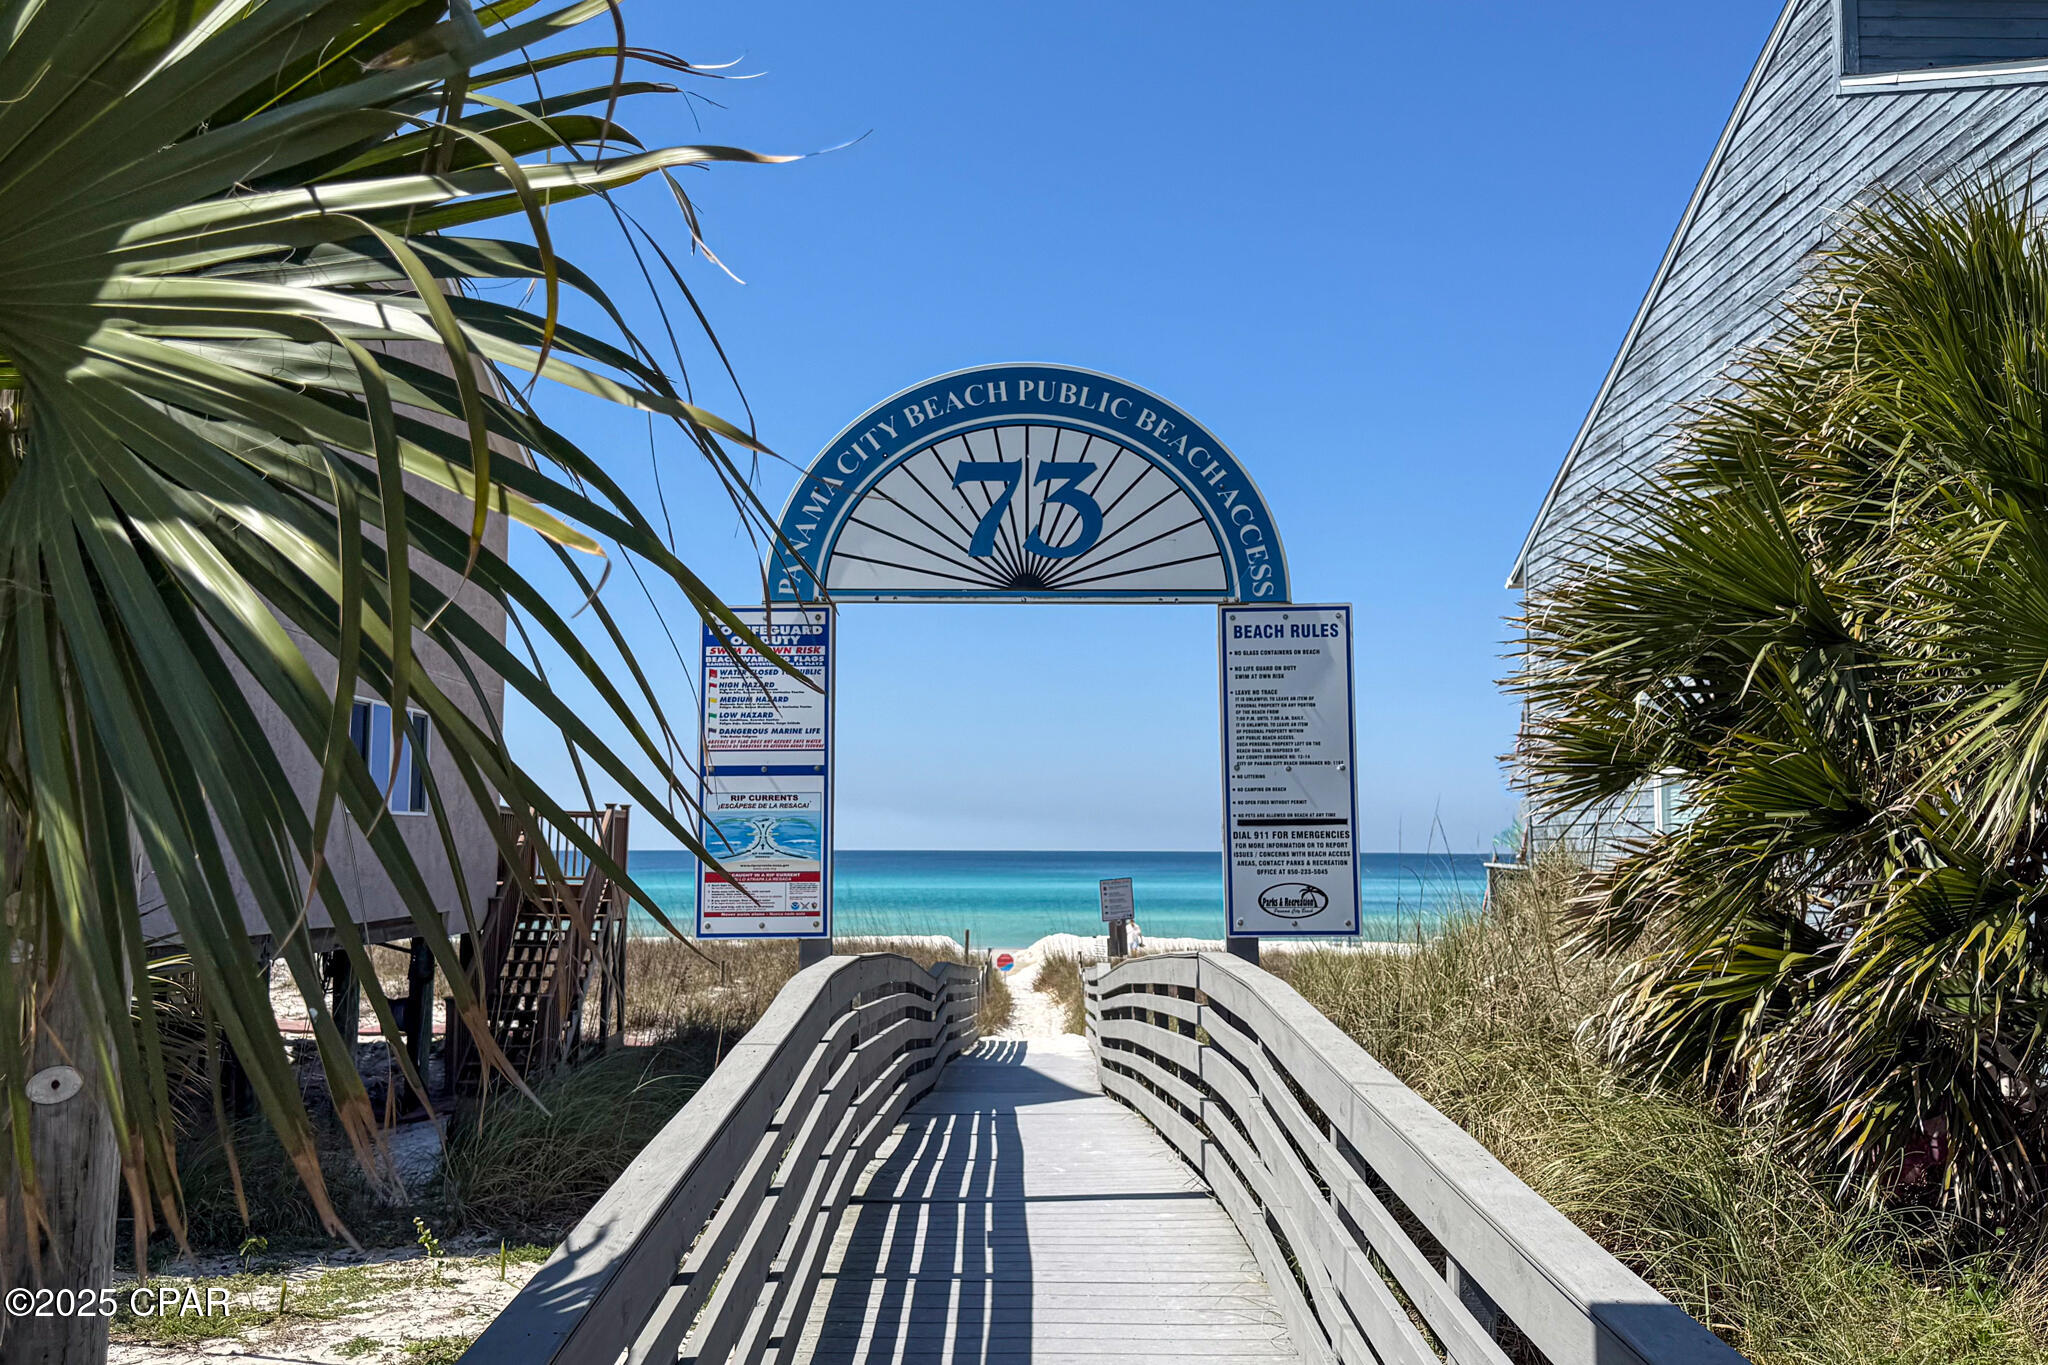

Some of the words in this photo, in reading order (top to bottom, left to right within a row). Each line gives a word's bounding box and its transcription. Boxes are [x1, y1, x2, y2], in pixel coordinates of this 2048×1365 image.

[779, 476, 844, 594] PANAMA
[837, 415, 898, 474] CITY
[903, 381, 1008, 428] BEACH
[1019, 380, 1133, 420] PUBLIC
[1136, 408, 1228, 486] BEACH
[1216, 486, 1274, 597] ACCESS
[952, 457, 1103, 559] 73
[1234, 625, 1284, 639] BEACH
[1290, 623, 1339, 638] RULES
[730, 636, 747, 645] O
[760, 636, 800, 645] DUTY
[1291, 831, 1350, 839] EMERGENCIES
[1262, 898, 1278, 906] Parks
[1279, 898, 1284, 906] &
[1285, 898, 1313, 906] Recreation
